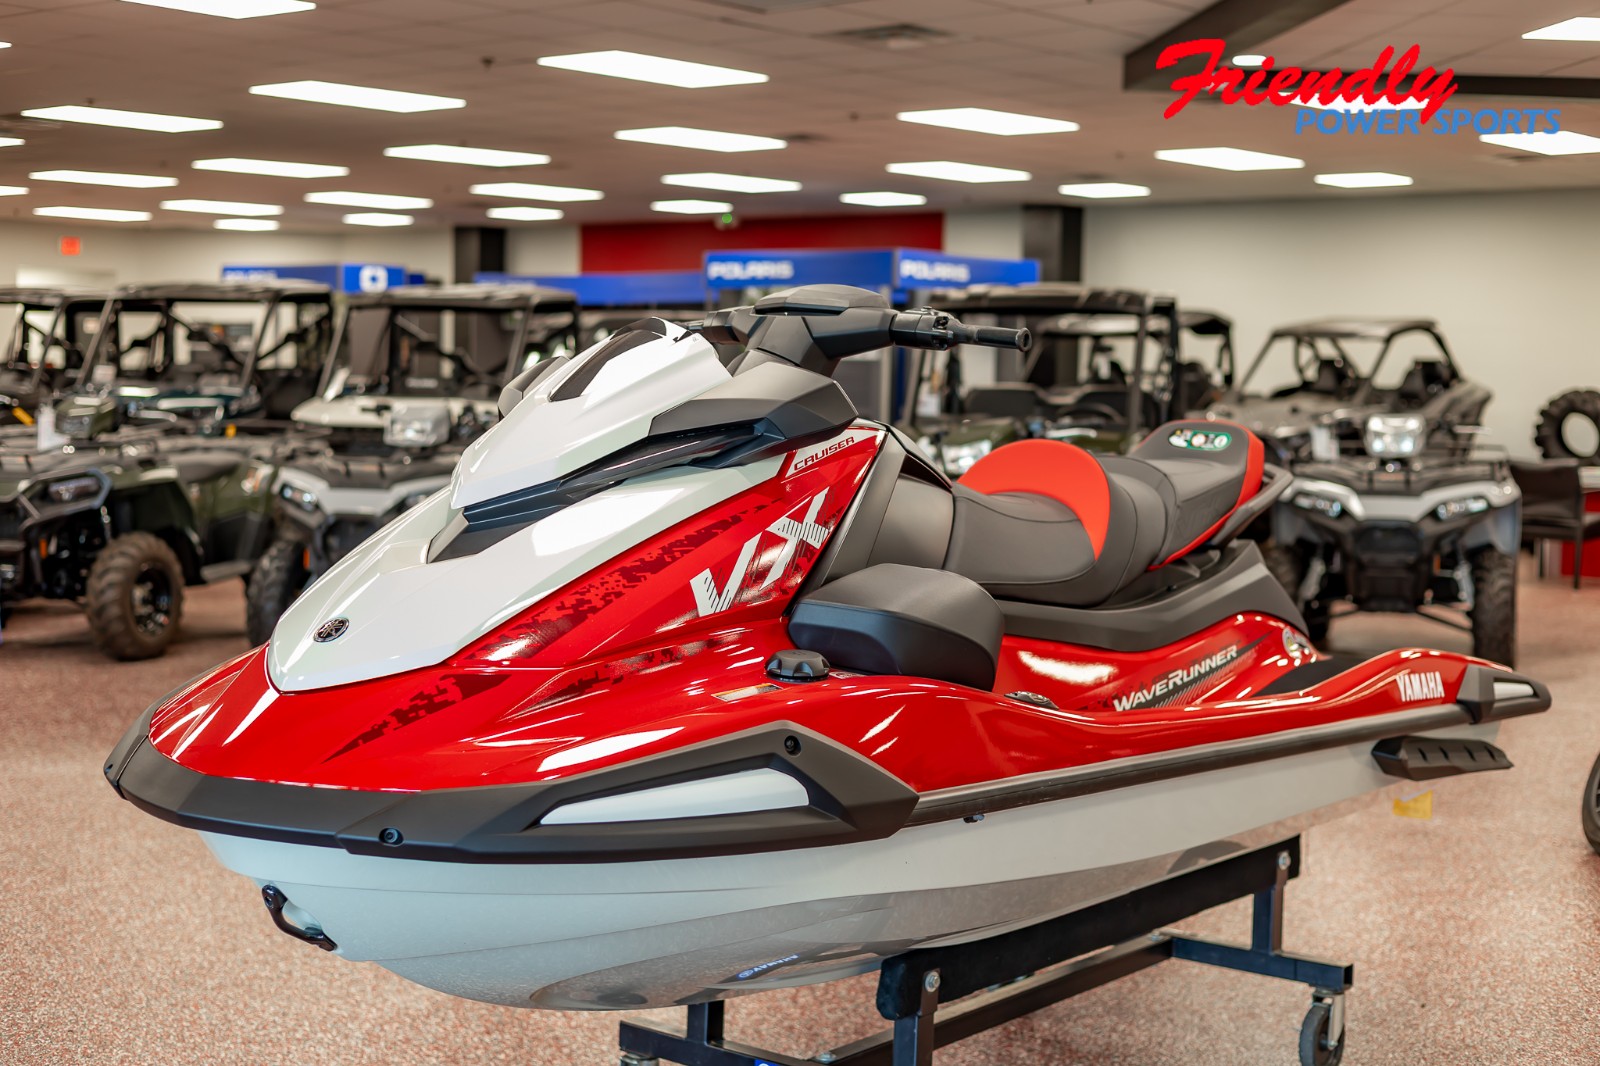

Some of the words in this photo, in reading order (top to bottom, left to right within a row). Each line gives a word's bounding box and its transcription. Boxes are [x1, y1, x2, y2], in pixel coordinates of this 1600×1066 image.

[708, 260, 794, 280] POLARIS
[900, 259, 970, 283] POLARIS
[793, 436, 855, 471] CRUISER
[689, 486, 830, 618] VX
[1395, 671, 1445, 702] YAMAHA
